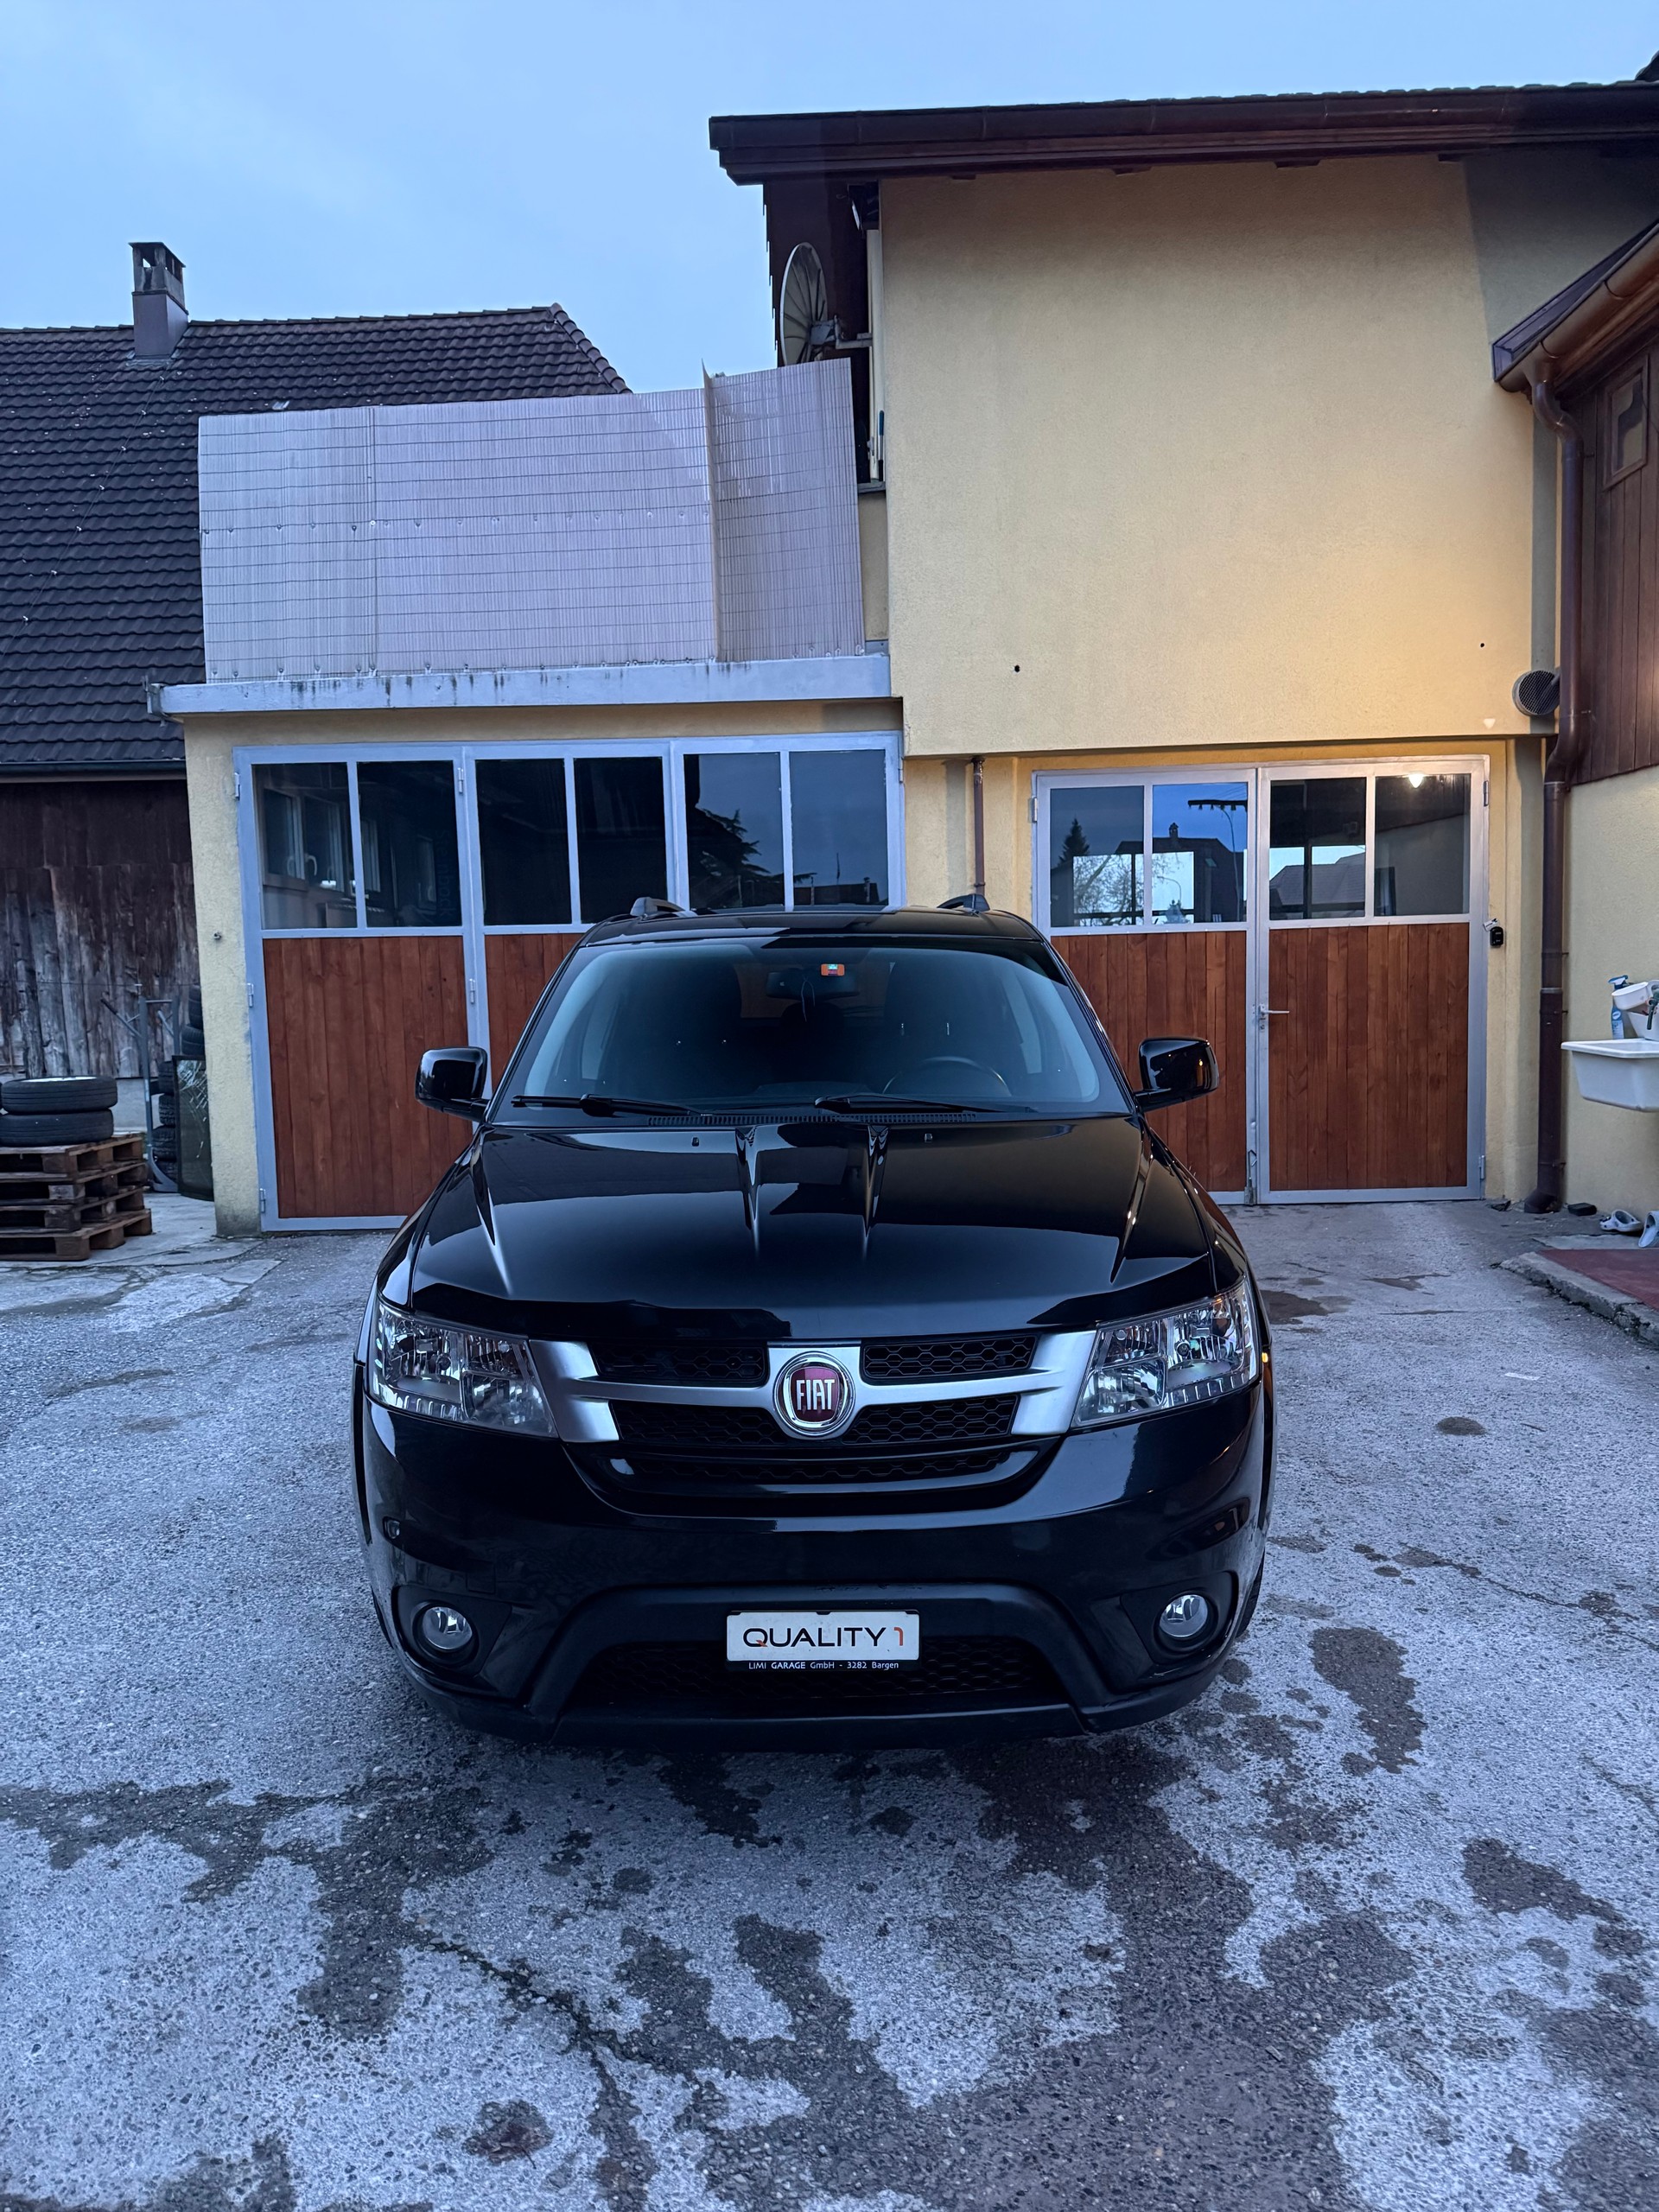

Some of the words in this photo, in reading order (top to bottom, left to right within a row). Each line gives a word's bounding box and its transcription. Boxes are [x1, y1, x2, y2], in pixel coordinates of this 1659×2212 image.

[796, 1379, 835, 1410] FIAT
[743, 1627, 887, 1648] QUALITY
[871, 1662, 899, 1671] Bargen
